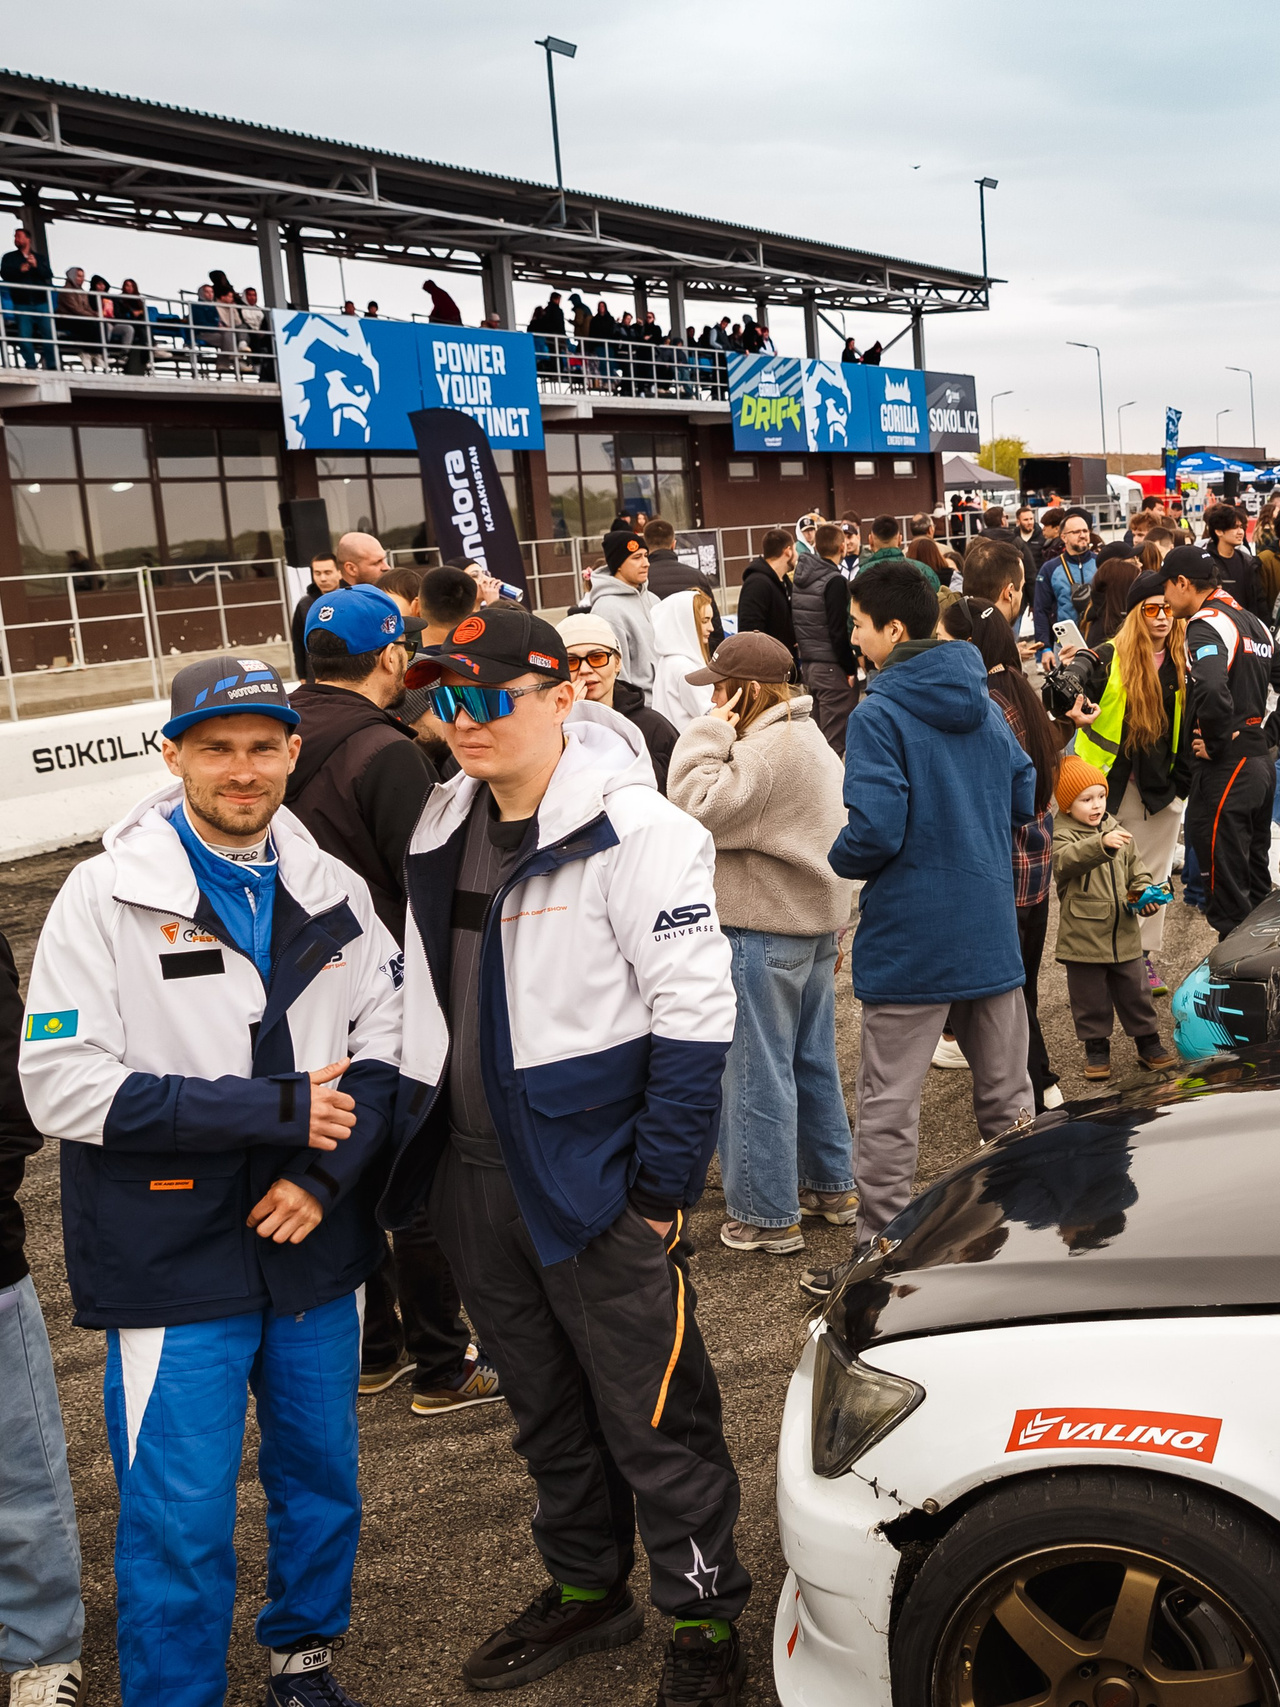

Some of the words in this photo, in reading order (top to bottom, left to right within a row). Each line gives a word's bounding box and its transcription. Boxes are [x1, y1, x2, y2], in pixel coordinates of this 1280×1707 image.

[432, 341, 506, 375] POWER
[436, 374, 492, 406] YOUR
[440, 406, 530, 437] TINCT
[740, 393, 801, 432] DRIFT
[880, 403, 920, 434] GORILLA
[929, 408, 979, 434] SOKOL.KZ
[468, 446, 495, 531] KAZAKHSTAN
[444, 450, 488, 571] ndora
[227, 685, 261, 700] MOTOR
[260, 683, 279, 693] OILS
[33, 731, 162, 773] SOKOL.K
[652, 904, 711, 933] ASP
[654, 925, 714, 942] UNIVERSE
[464, 1374, 497, 1396] N
[303, 1650, 328, 1666] OMP
